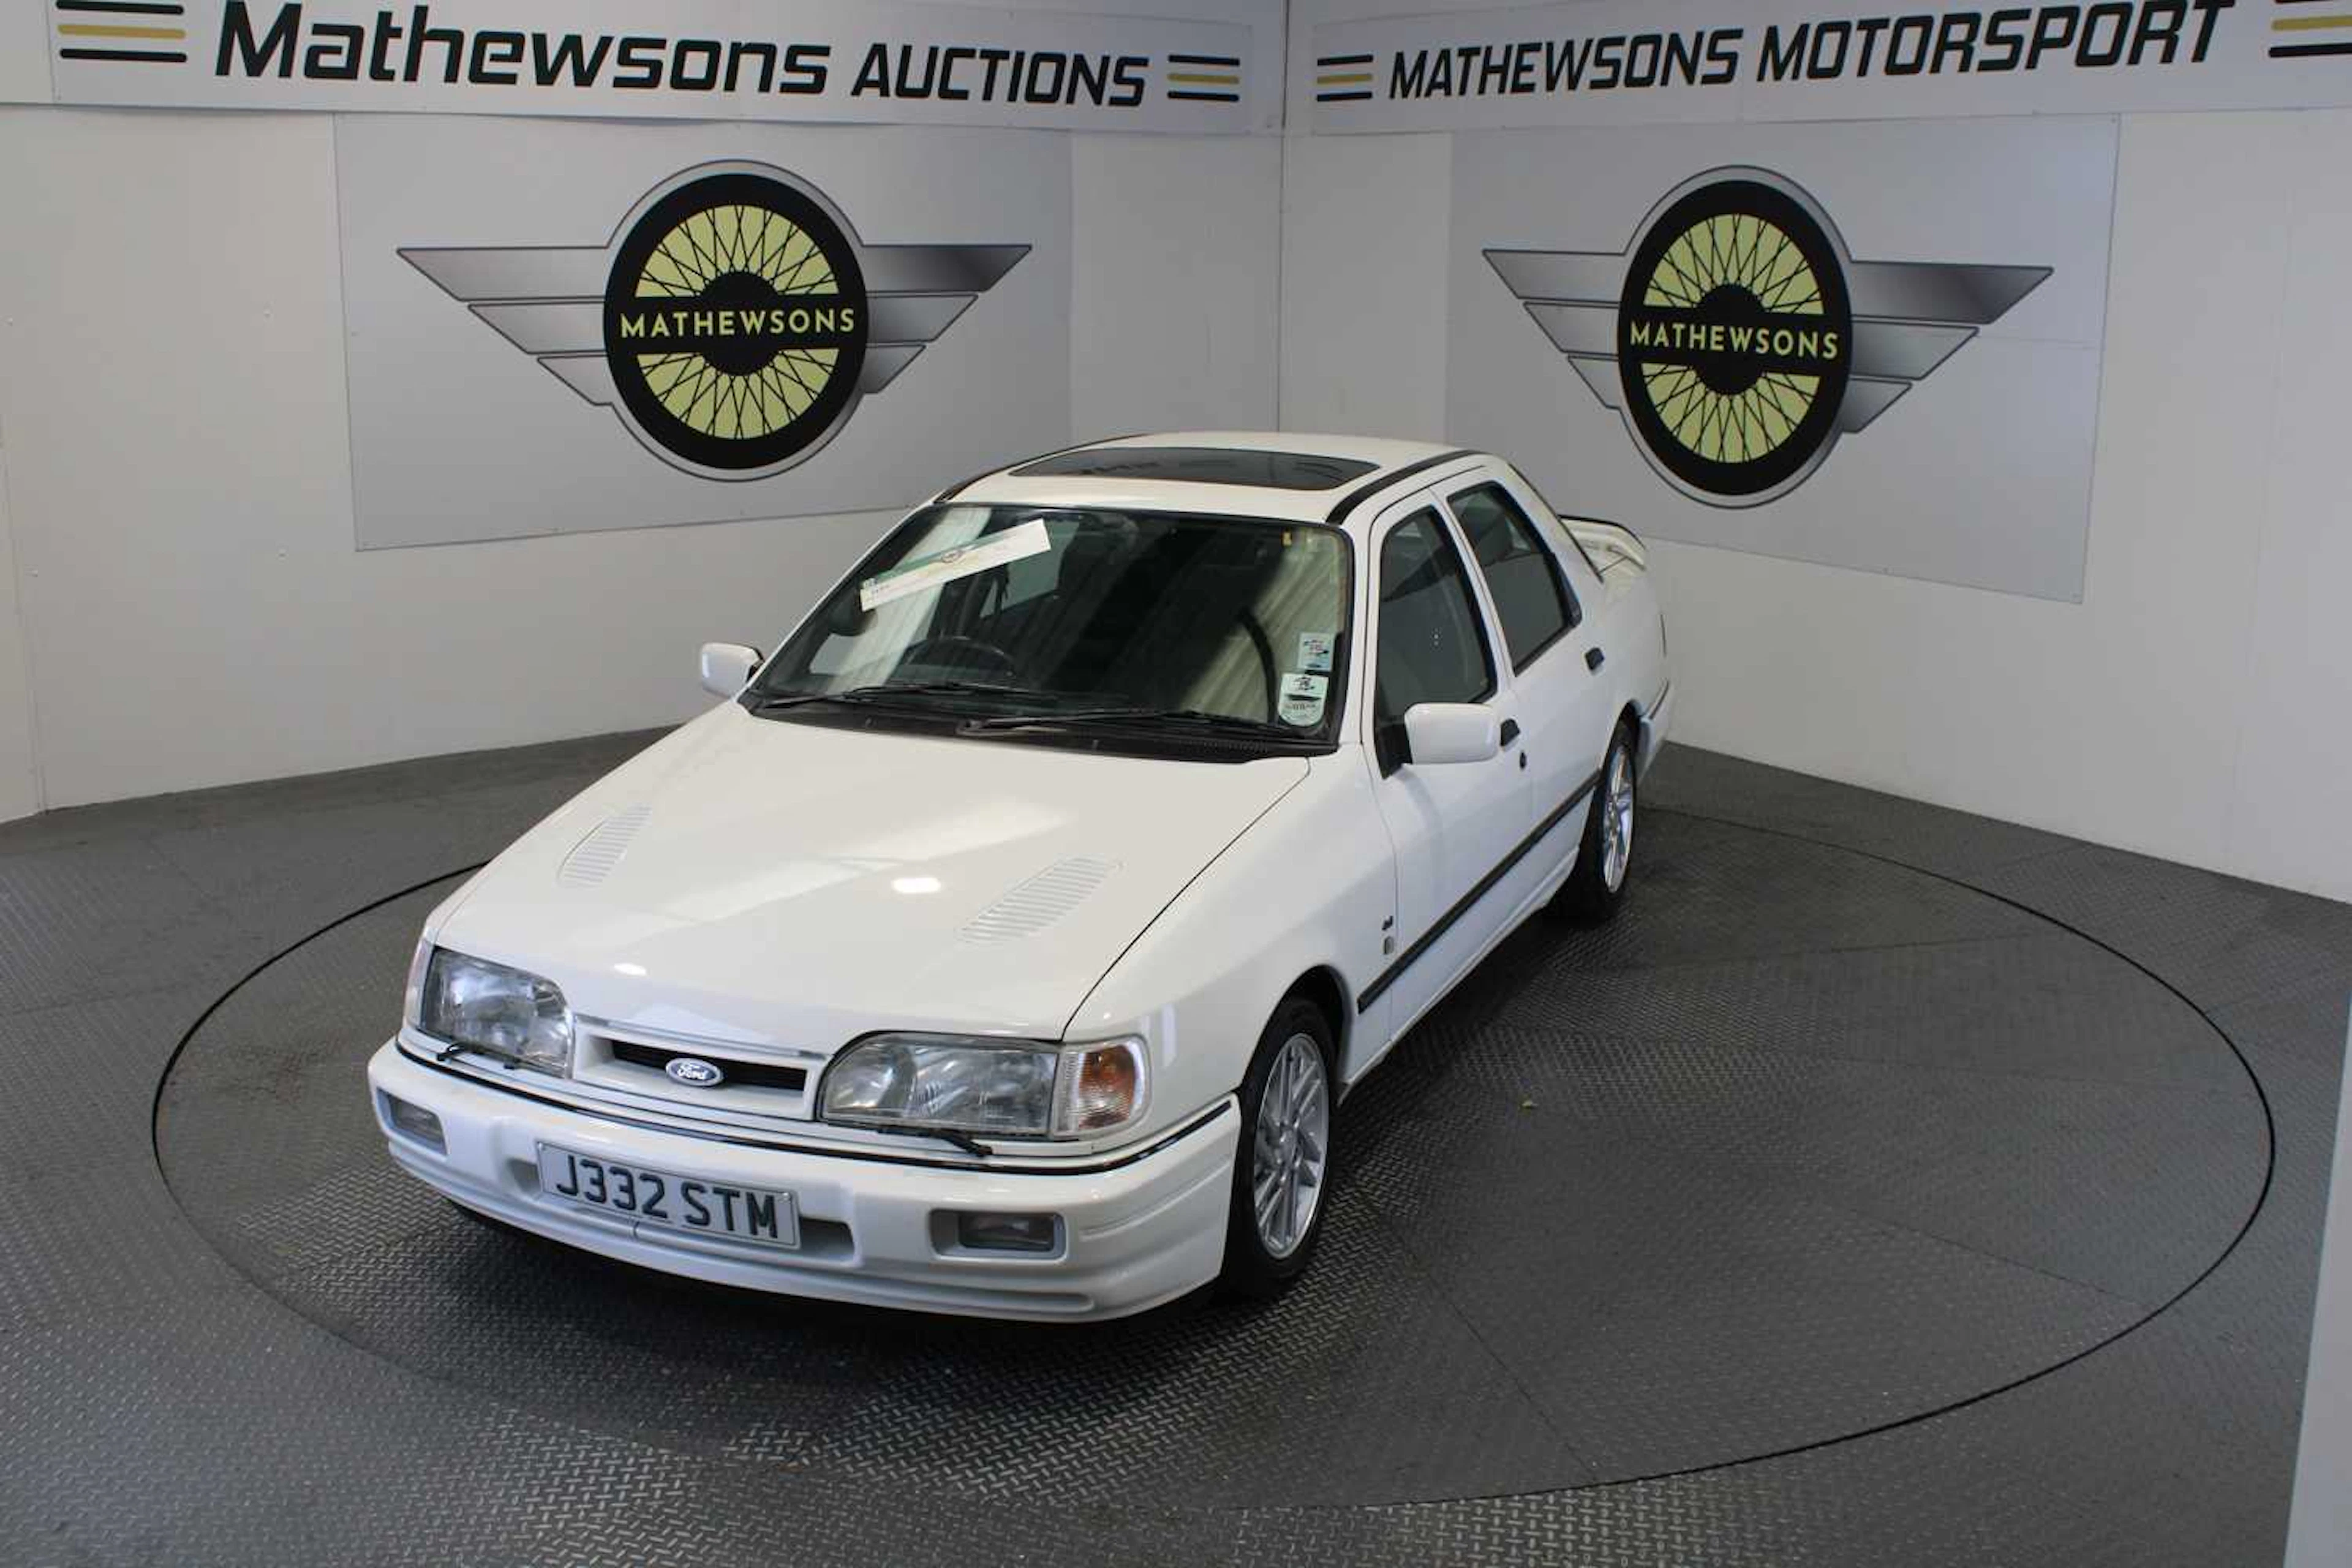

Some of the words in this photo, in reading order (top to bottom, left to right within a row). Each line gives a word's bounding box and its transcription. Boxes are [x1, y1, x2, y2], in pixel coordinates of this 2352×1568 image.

[216, 1, 831, 94] Mathewsons
[851, 43, 1149, 107] AUCTIONS
[1389, 28, 1744, 100] MATHEWSONS
[1756, 0, 2235, 82] MOTORSPORT
[619, 307, 854, 338] MATHEWSONS
[1630, 320, 1838, 360] MATHEWSONS
[676, 1062, 709, 1080] Ford
[556, 1155, 668, 1219] J332
[680, 1181, 778, 1238] STM
